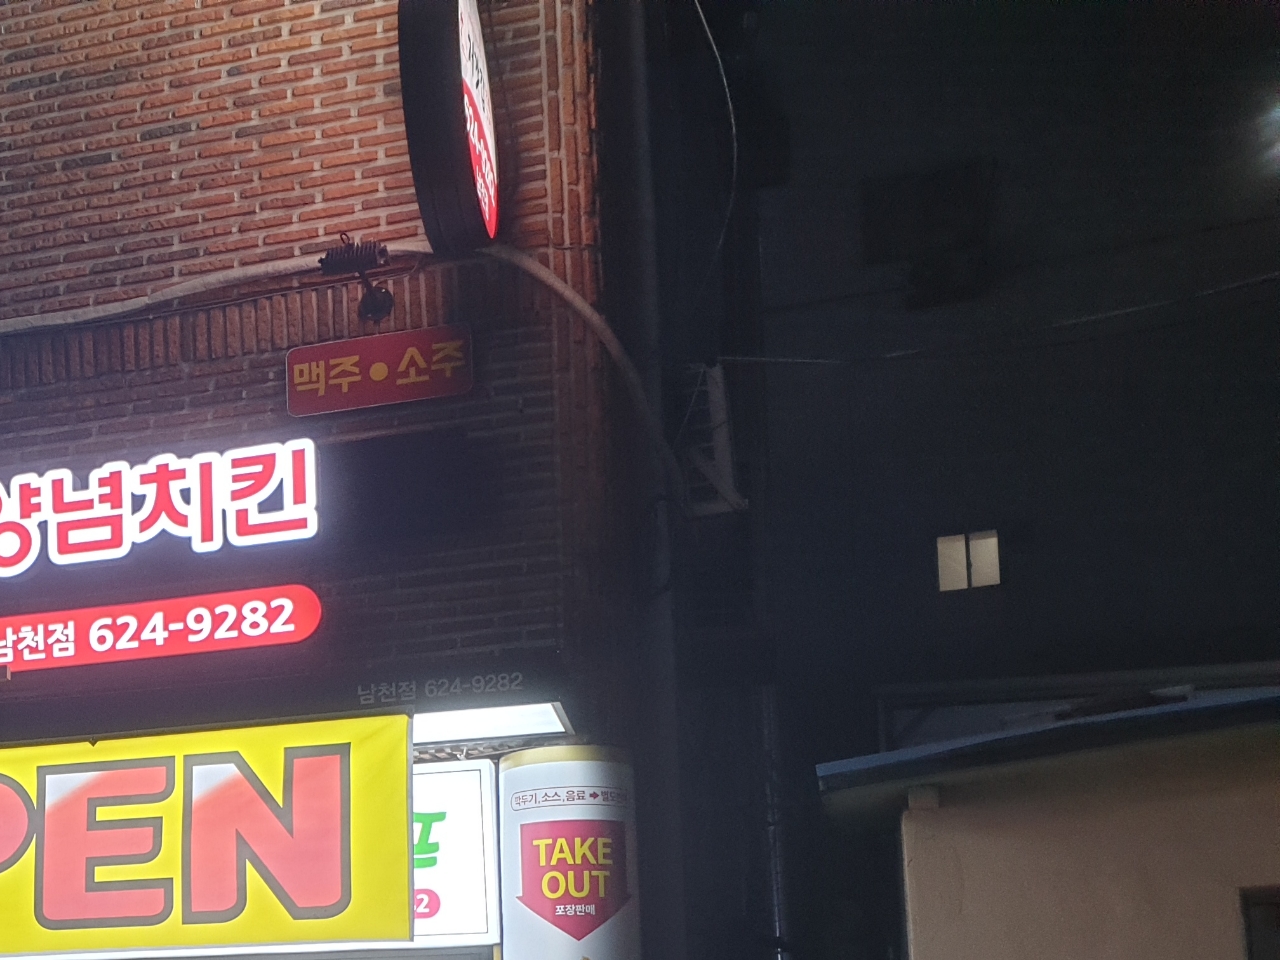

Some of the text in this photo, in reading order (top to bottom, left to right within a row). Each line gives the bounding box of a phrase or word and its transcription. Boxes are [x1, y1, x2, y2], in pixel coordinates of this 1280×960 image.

[293, 340, 465, 397] 맥주 소주
[89, 597, 296, 653] 624-9282
[357, 672, 523, 705] 남천점 624-9282
[533, 837, 613, 866] TAKE
[542, 870, 610, 899] OUT
[555, 904, 595, 915] 포장판매
